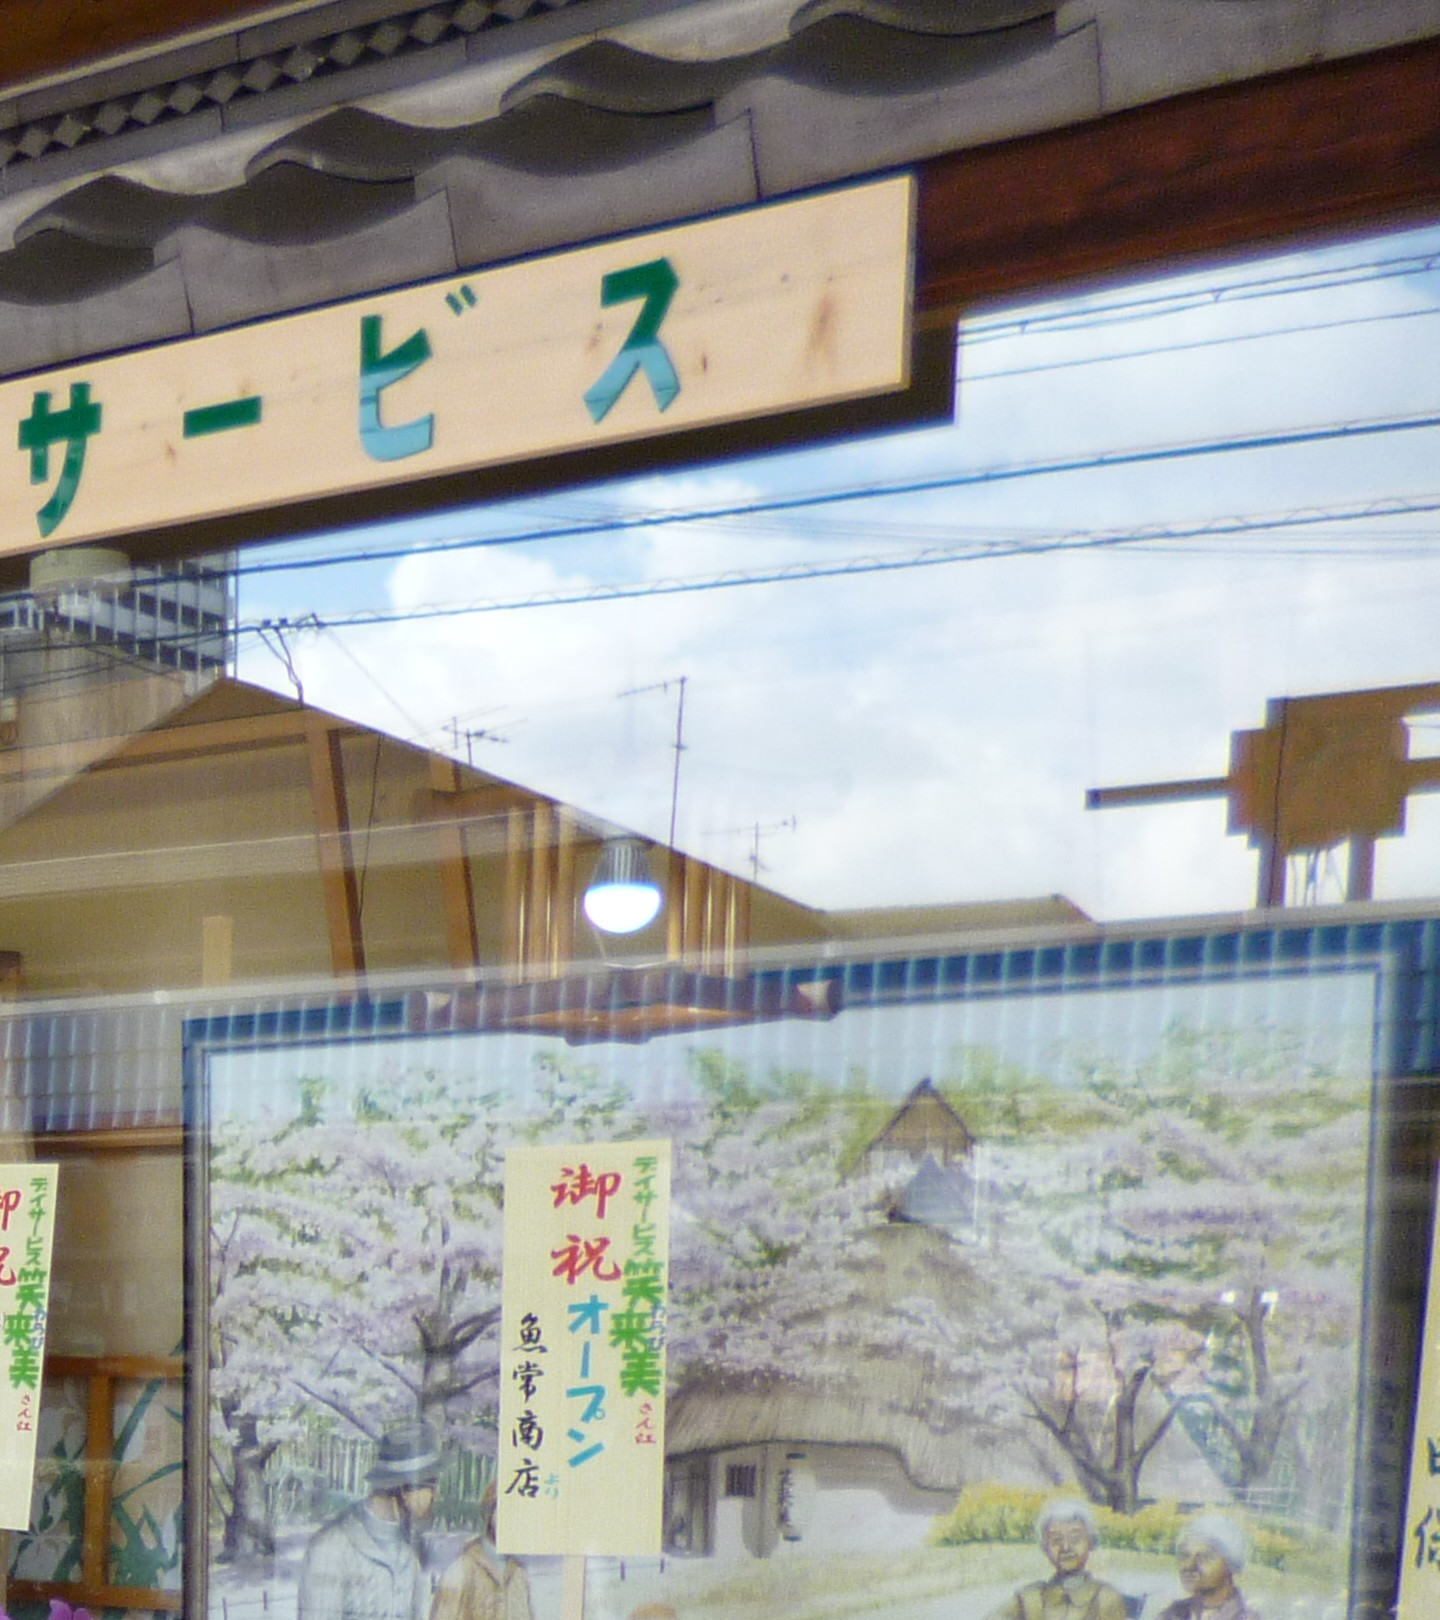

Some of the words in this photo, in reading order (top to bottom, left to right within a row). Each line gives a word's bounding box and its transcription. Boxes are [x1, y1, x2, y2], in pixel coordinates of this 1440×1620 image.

[550, 1163, 622, 1285] 御祝
[565, 1294, 610, 1469] オープン
